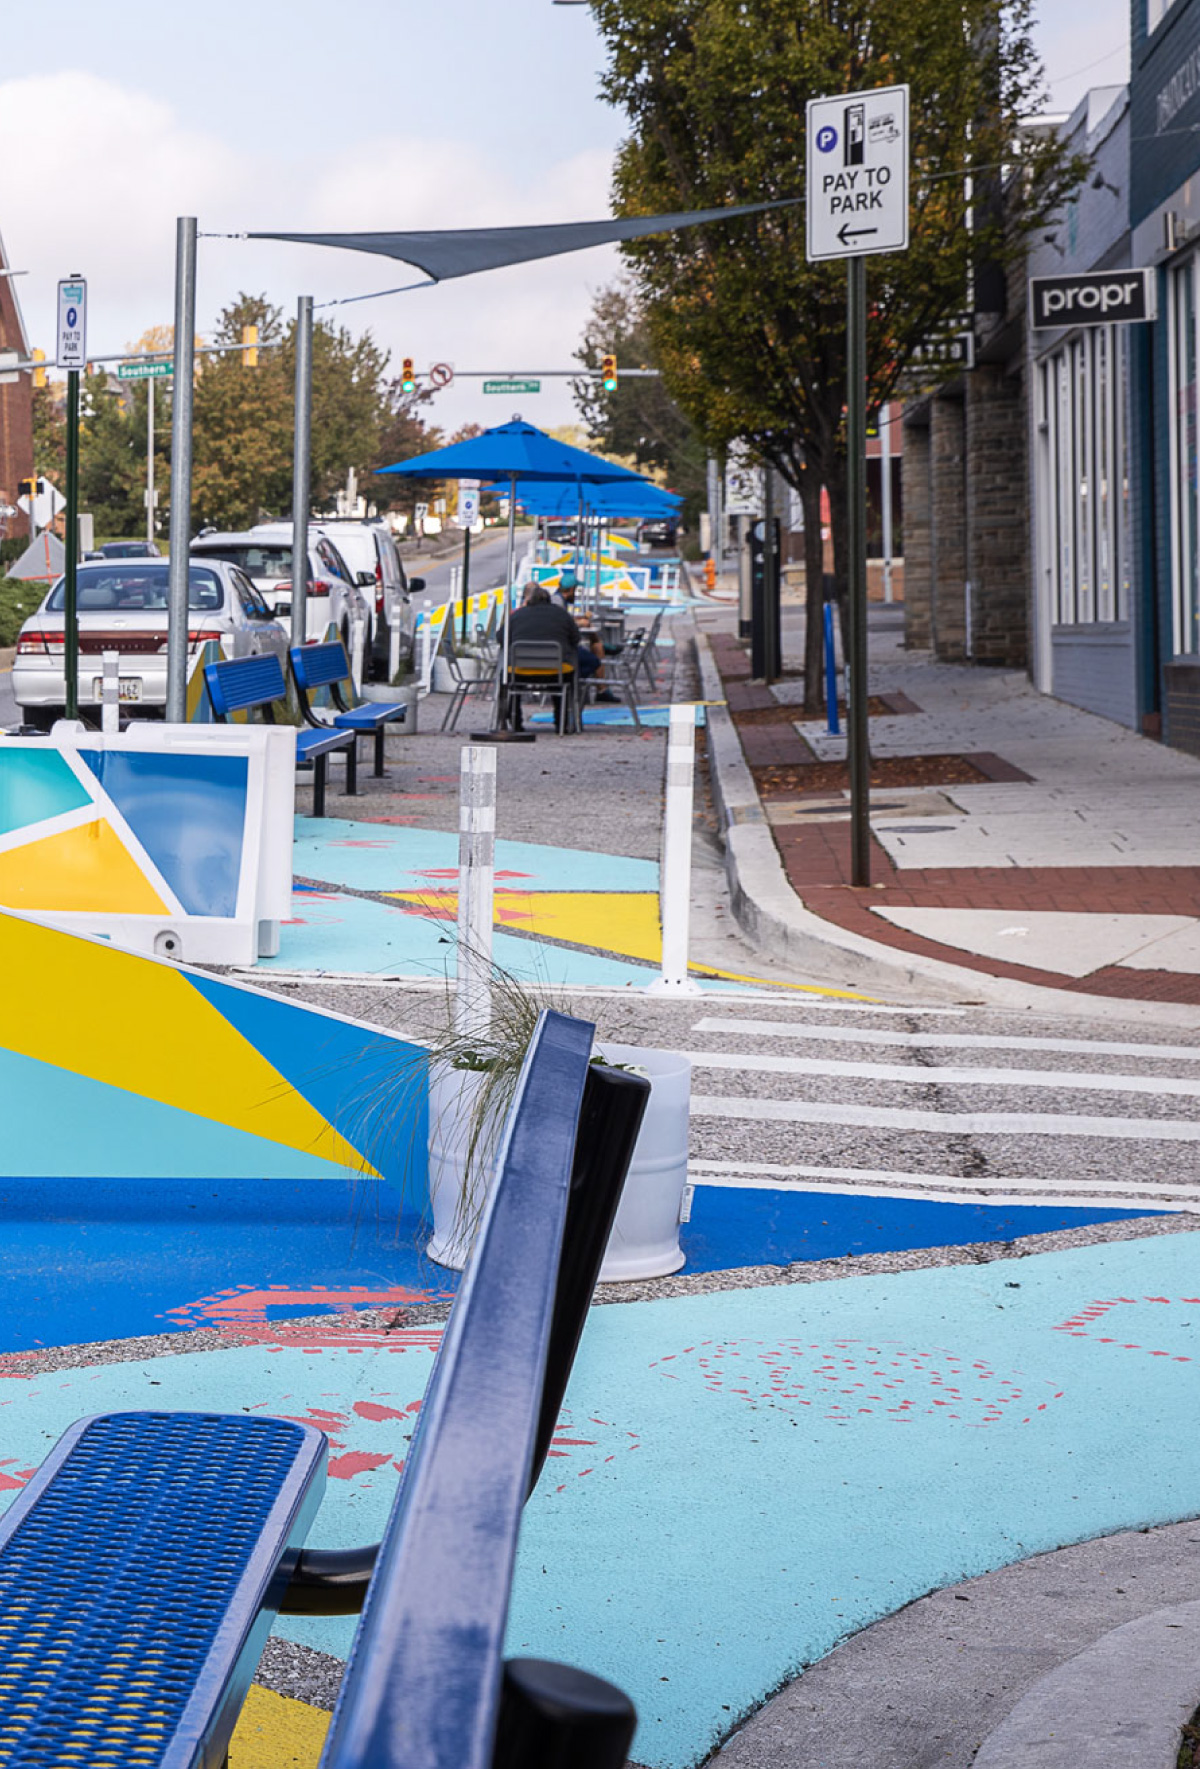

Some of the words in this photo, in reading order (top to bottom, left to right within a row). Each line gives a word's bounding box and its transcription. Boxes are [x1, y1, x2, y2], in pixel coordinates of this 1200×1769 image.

[822, 170, 858, 193] PAY
[865, 165, 891, 187] TO
[830, 190, 883, 215] PARK
[1042, 281, 1138, 317] propr
[120, 365, 167, 377] Southern
